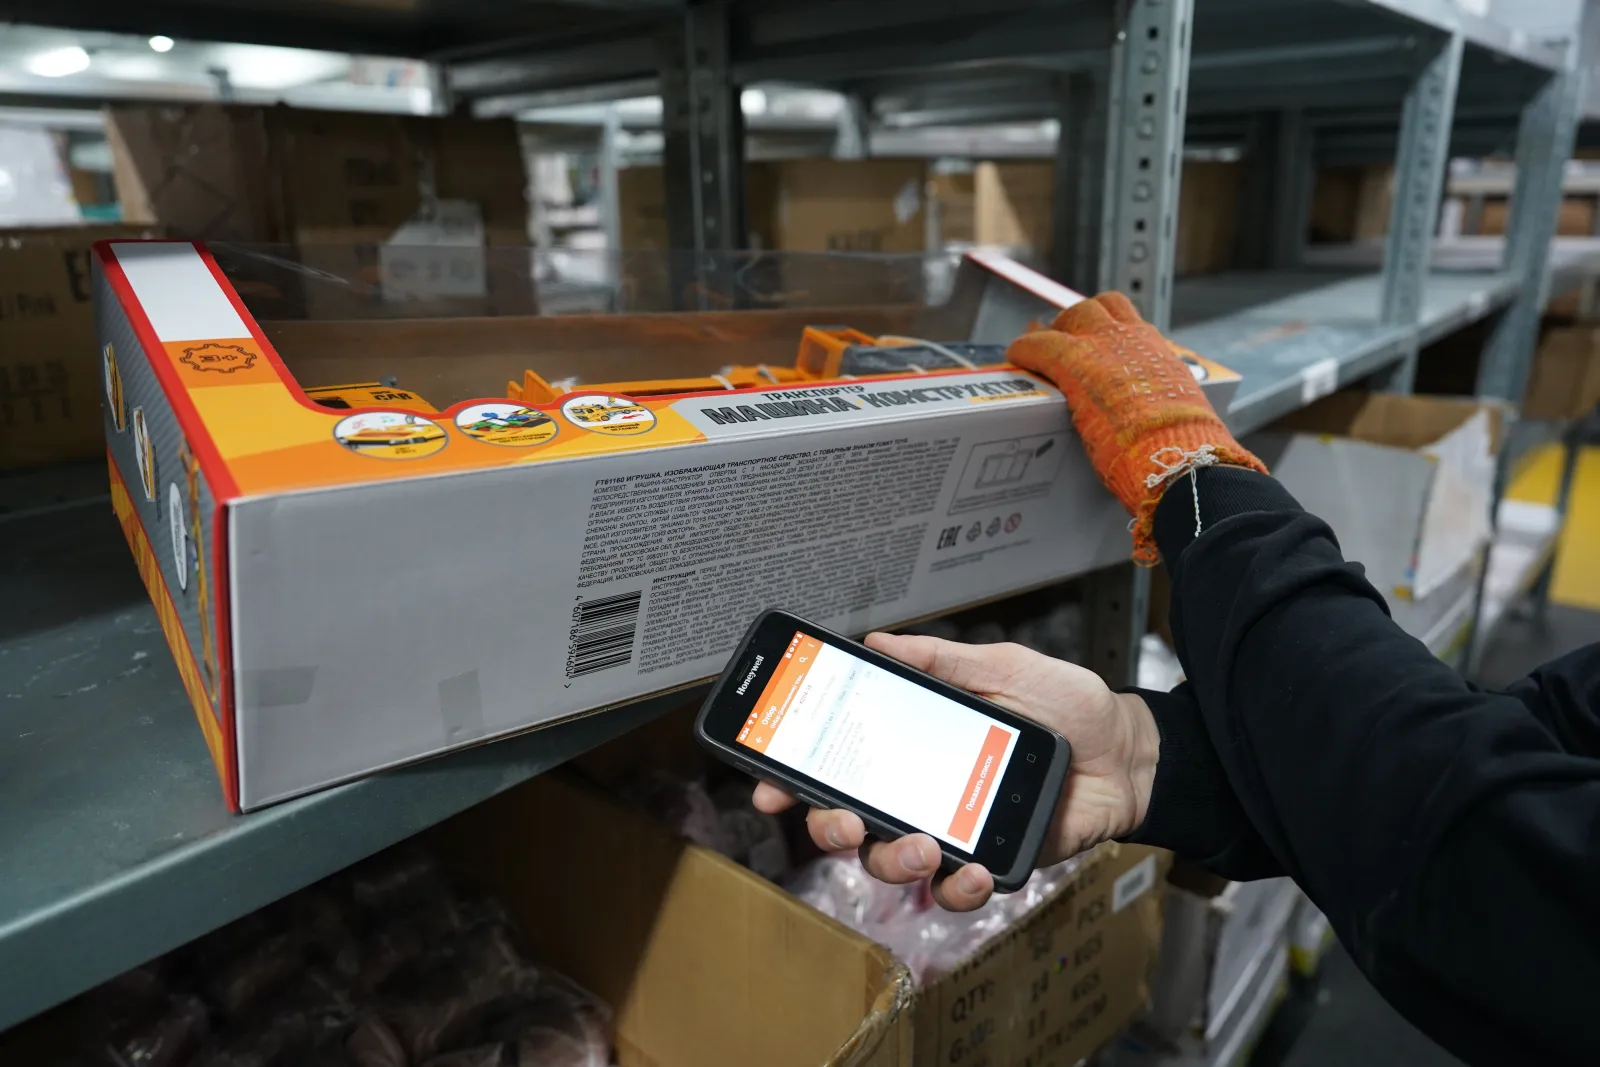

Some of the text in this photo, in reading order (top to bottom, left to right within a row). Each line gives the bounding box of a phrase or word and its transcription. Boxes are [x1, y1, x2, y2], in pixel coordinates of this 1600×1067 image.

[374, 392, 412, 400] CAR
[762, 386, 865, 402] ТРАНСПОРТЕР
[700, 396, 861, 425] МАШИНА
[595, 477, 625, 486] FT61160
[586, 524, 617, 534] CHENGHAI
[584, 533, 610, 542] ФИЛИАЛ
[582, 548, 606, 557] СТРАНА
[579, 560, 624, 573] ТРЕБОВАНИЯМ
[578, 570, 608, 580] КАЧЕСТВУ
[570, 606, 582, 641] 607186
[565, 643, 577, 678] 594604
[735, 653, 765, 696] Honeywell
[760, 703, 777, 726] Отбор
[966, 753, 993, 811] Показать список
